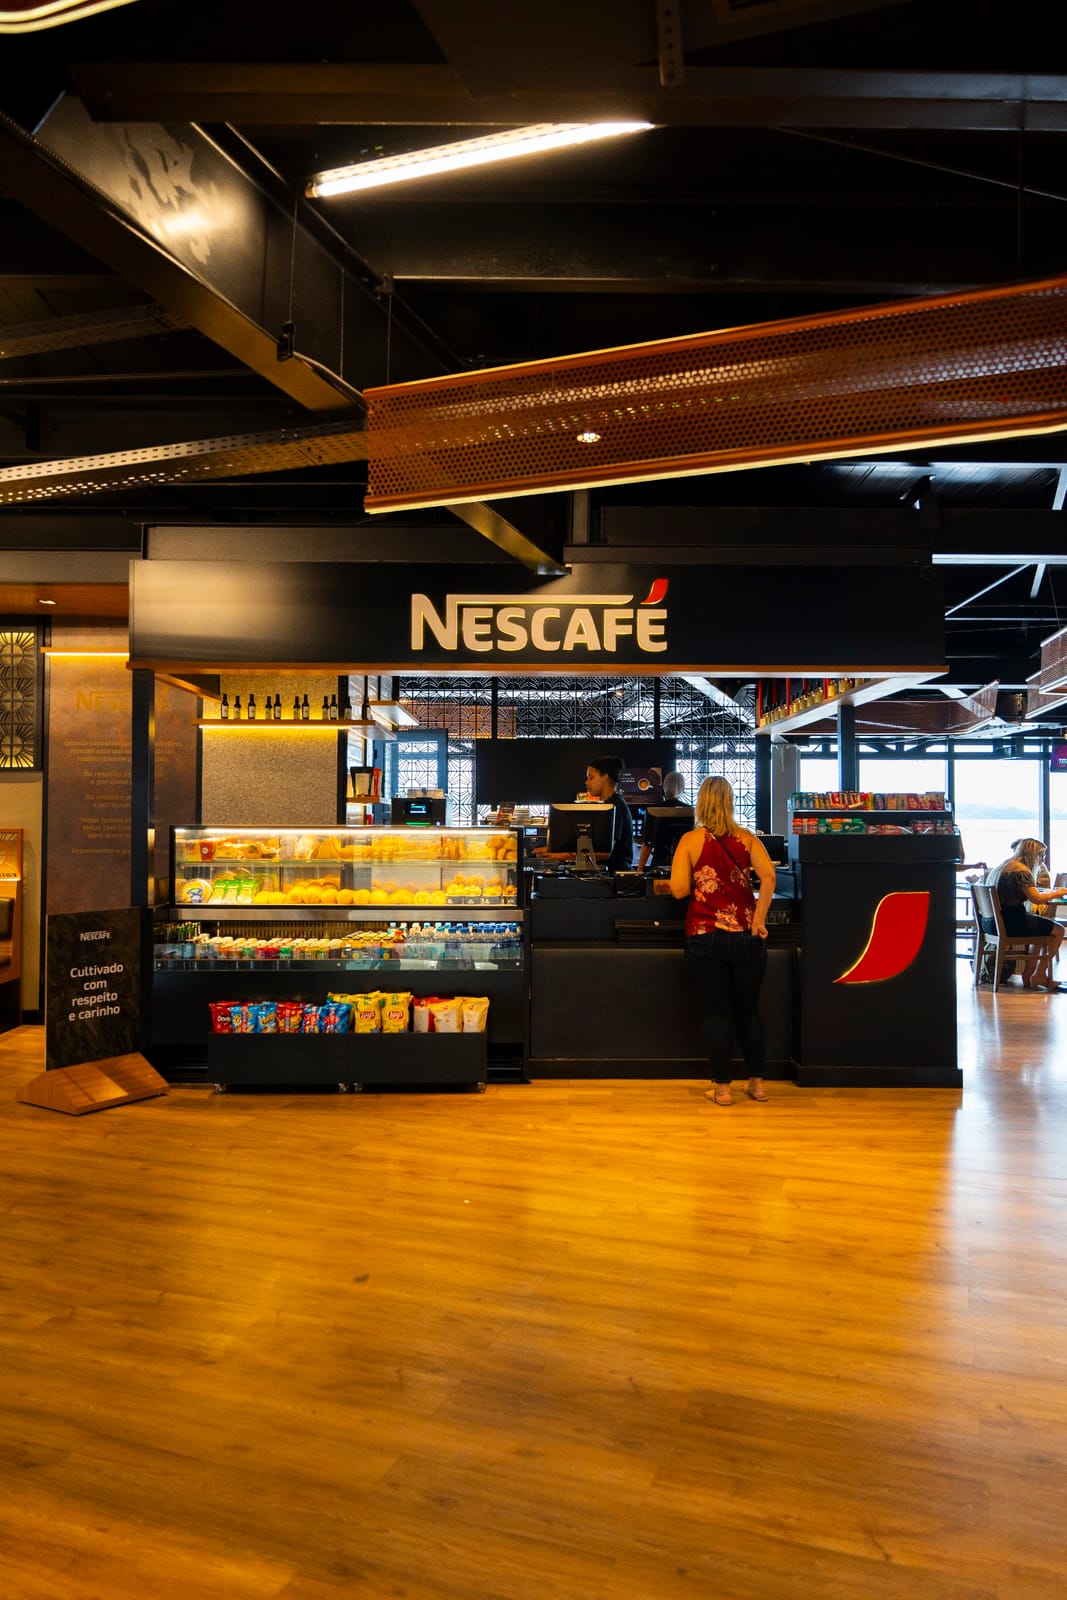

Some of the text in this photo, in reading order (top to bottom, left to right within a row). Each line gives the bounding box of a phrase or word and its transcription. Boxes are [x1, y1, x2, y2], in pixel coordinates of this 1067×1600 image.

[70, 962, 124, 978] Cultivado
[83, 979, 107, 991] com
[71, 991, 118, 1007] respeito
[68, 1005, 121, 1022] e carinho
